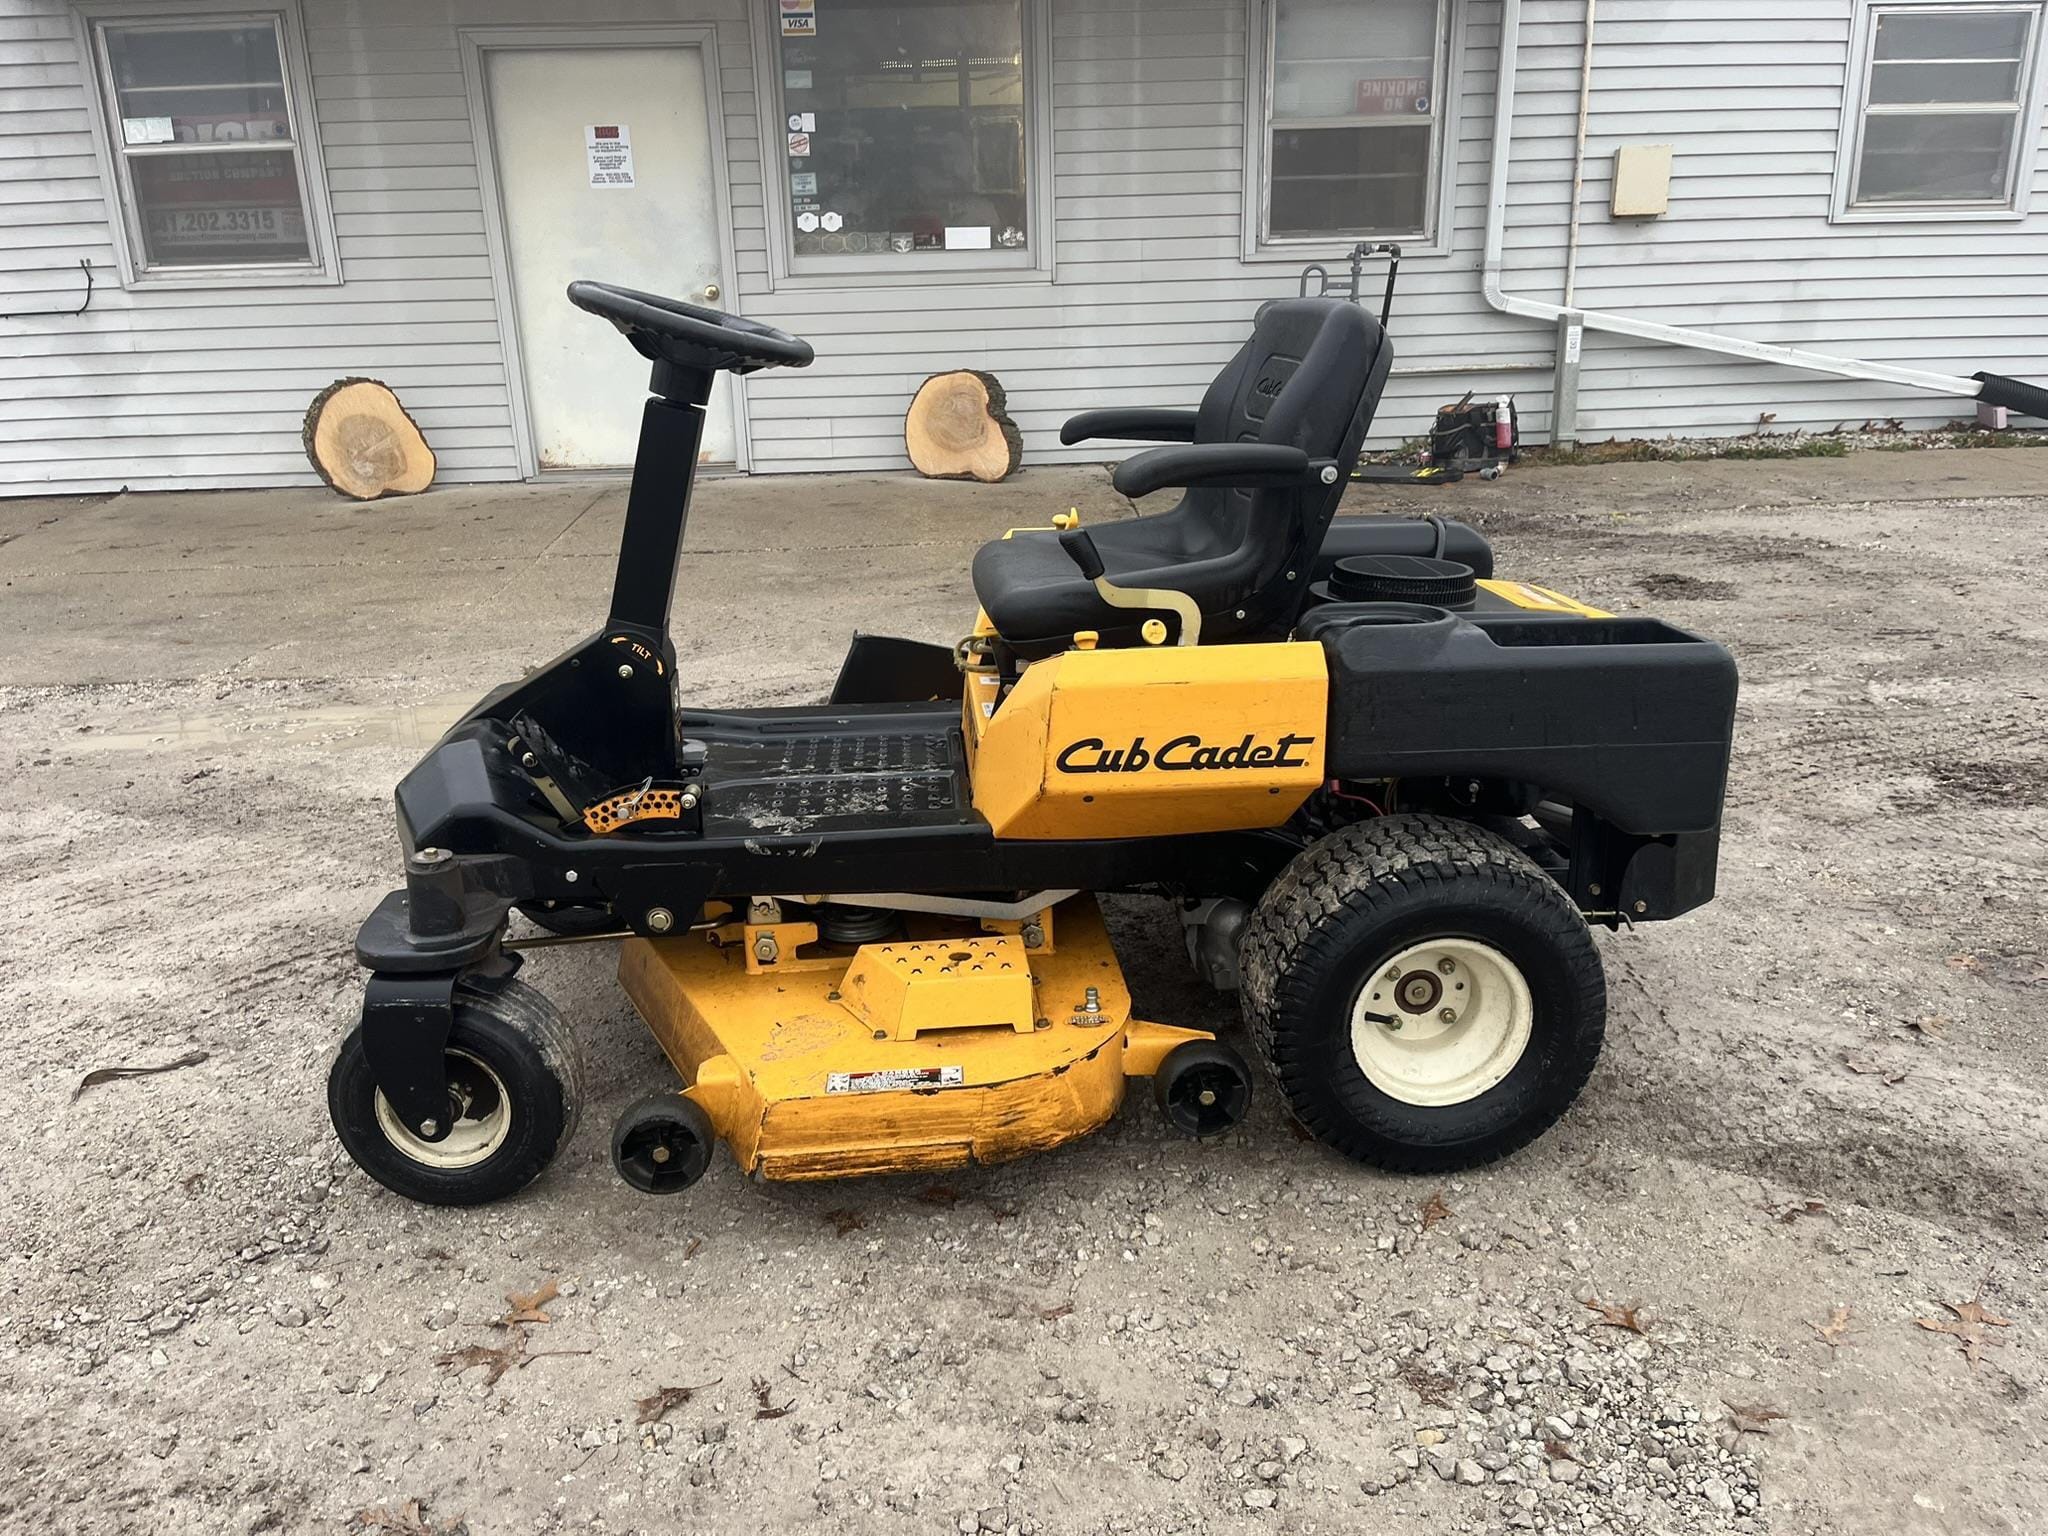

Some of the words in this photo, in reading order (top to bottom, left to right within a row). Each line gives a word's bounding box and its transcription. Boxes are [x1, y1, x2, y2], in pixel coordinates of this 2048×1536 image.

[788, 19, 809, 28] VISA
[1362, 79, 1428, 97] SMOKING
[1383, 97, 1404, 111] NO
[631, 642, 652, 660] TILT
[1056, 737, 1150, 773] Cub
[1154, 733, 1315, 770] Cadet
